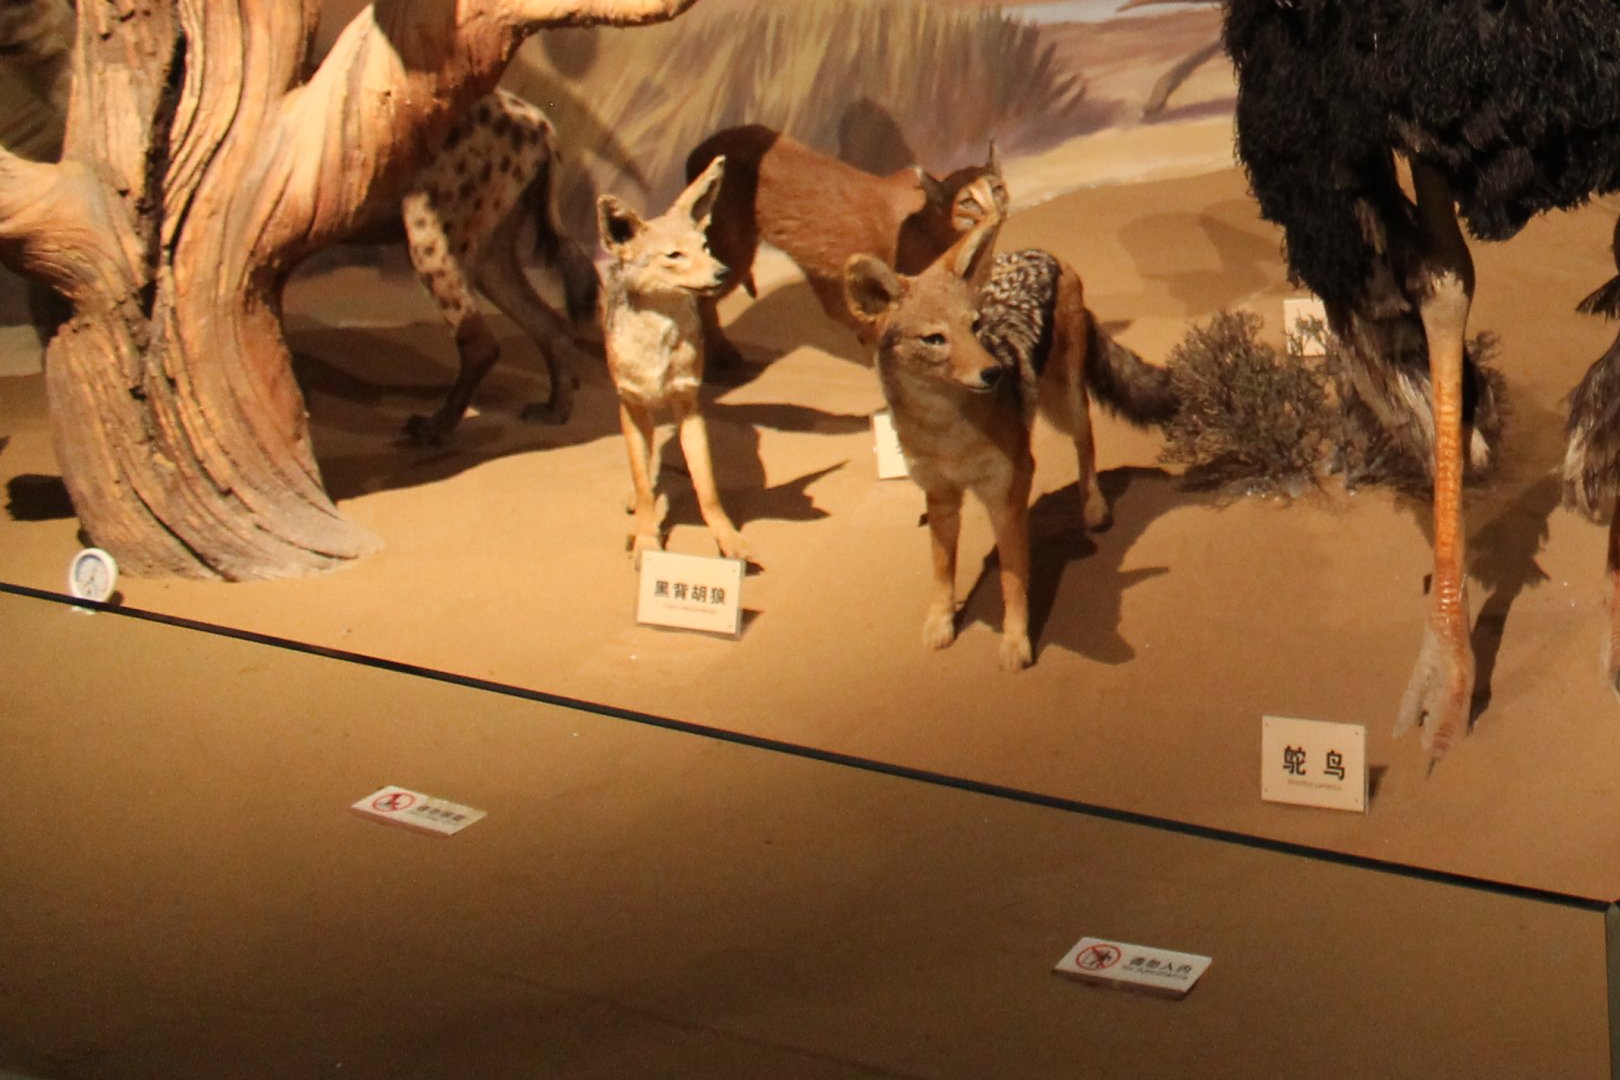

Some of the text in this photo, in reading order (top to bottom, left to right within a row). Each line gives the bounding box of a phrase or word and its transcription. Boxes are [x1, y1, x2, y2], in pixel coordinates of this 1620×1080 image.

[654, 580, 726, 605] 黑背胡狼
[1283, 745, 1346, 781] 鸵鸟
